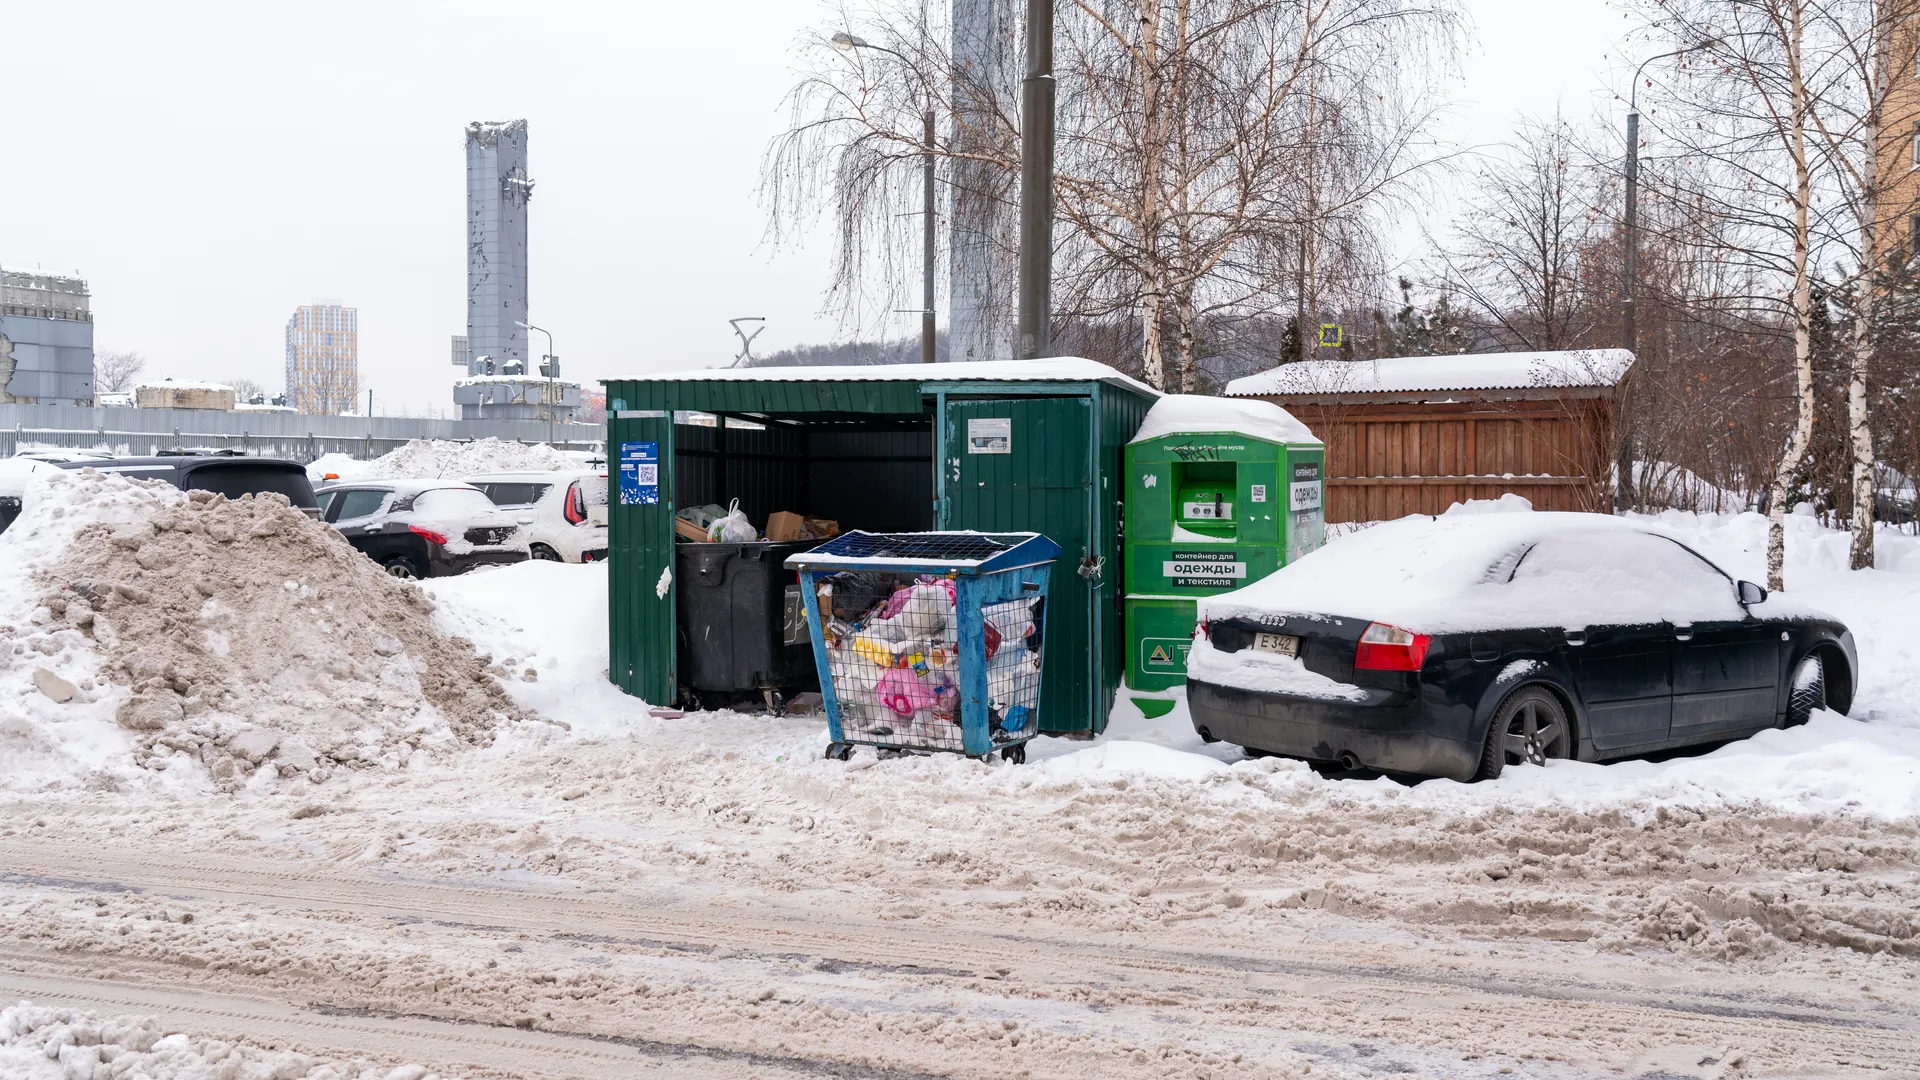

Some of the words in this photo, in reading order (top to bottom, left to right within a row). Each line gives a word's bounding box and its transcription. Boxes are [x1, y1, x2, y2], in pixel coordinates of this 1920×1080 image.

[1295, 487, 1318, 504] одежды
[1174, 564, 1235, 574] одежды
[1271, 636, 1292, 651] 342
